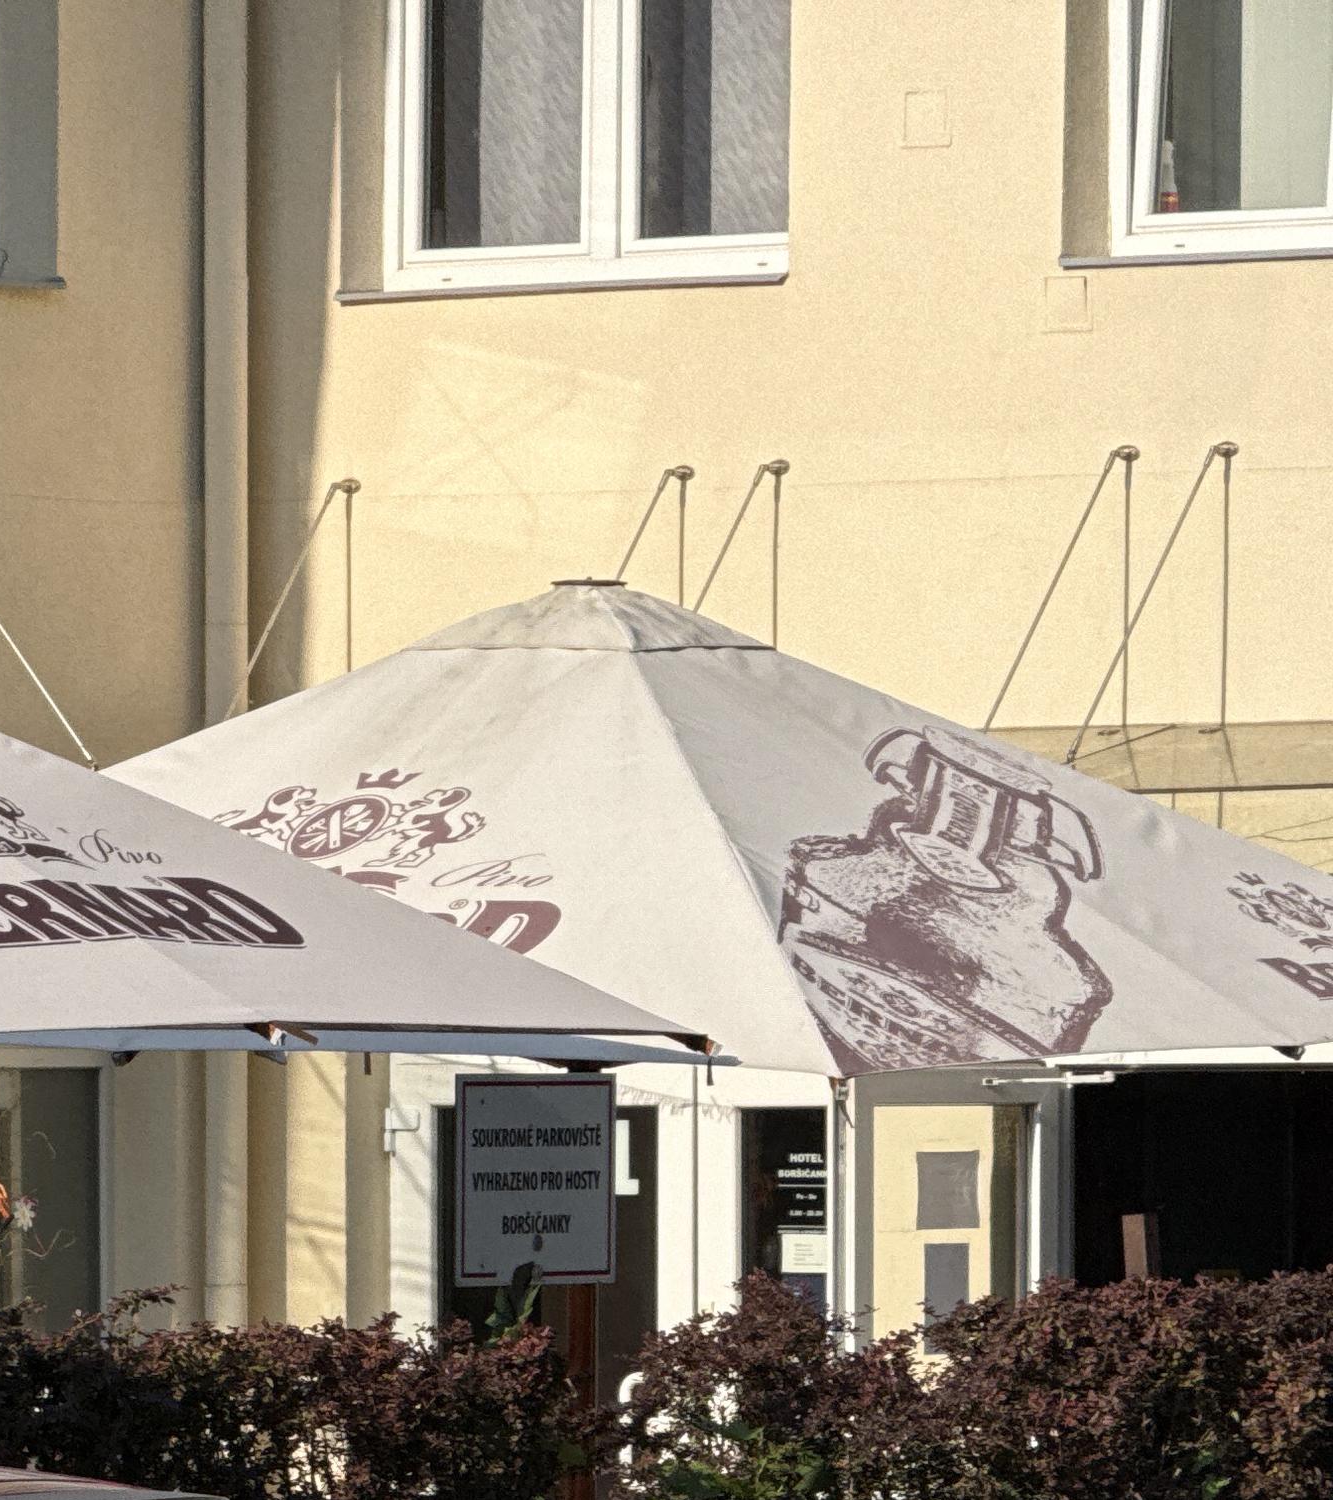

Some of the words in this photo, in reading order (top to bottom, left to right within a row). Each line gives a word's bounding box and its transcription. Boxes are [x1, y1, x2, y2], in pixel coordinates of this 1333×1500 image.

[79, 829, 163, 864] Pivo
[430, 853, 554, 888] Pivo
[472, 1124, 533, 1148] SOUKROMÉ
[789, 1153, 824, 1163] HOTEL
[472, 1172, 538, 1191] VYHRAZENO
[541, 1171, 563, 1190] PRO
[566, 1170, 601, 1190] HOSTY
[502, 1212, 572, 1234] BORŠIČANKY
